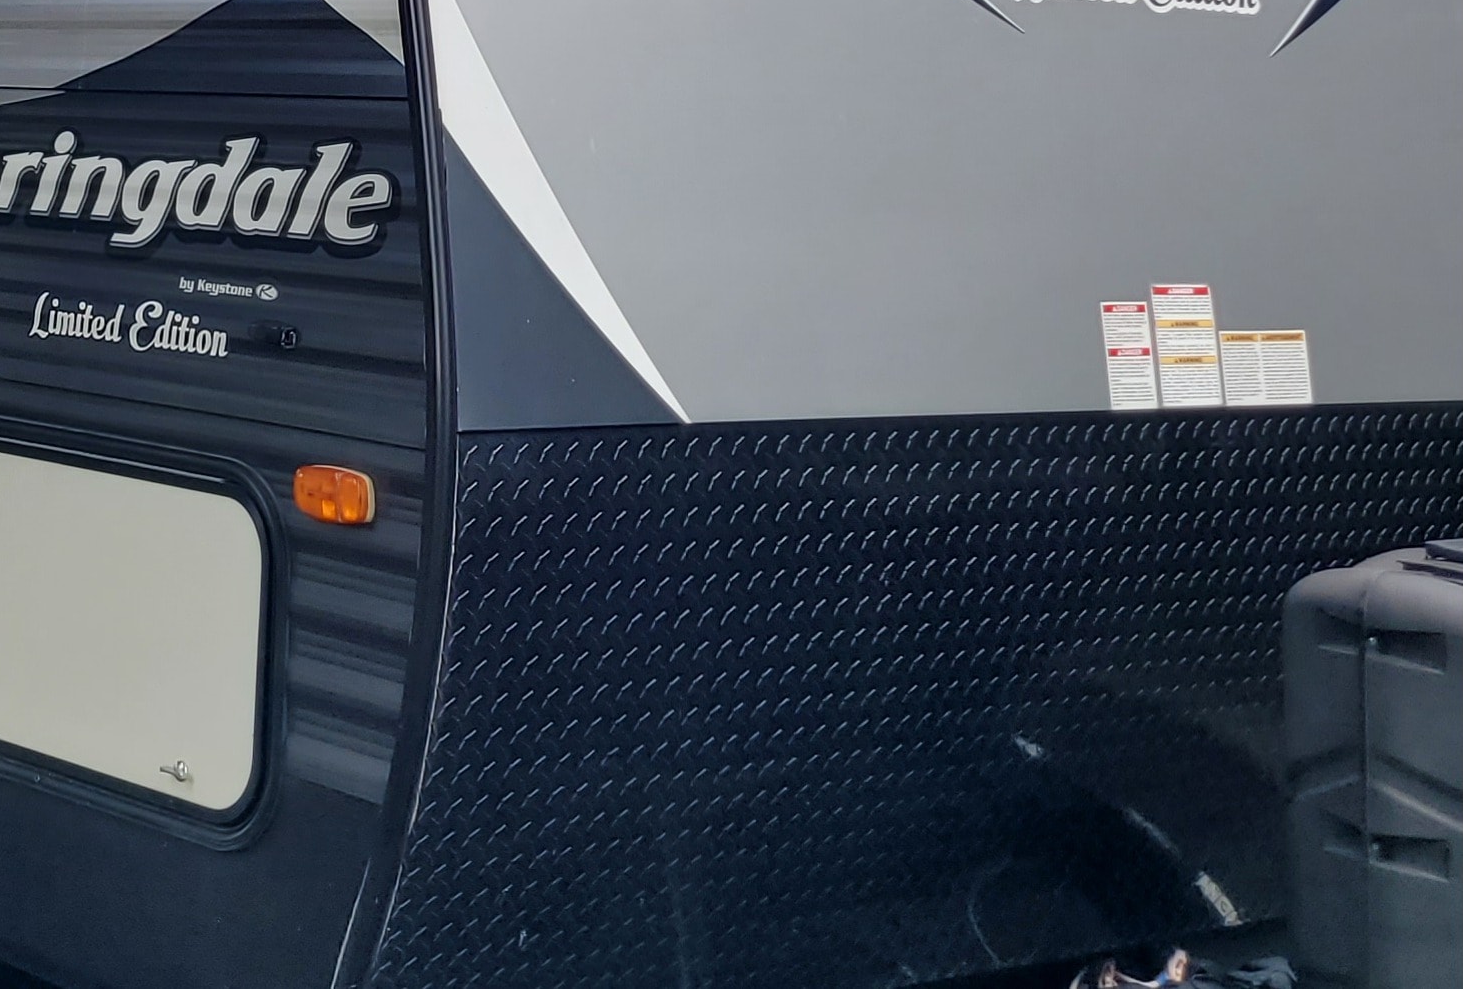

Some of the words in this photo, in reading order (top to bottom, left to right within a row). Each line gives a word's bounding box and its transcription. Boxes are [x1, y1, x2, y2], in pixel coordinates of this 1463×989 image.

[179, 276, 195, 293] by
[197, 278, 253, 297] Keystone
[29, 292, 123, 343] Limited
[129, 300, 228, 357] Edition
